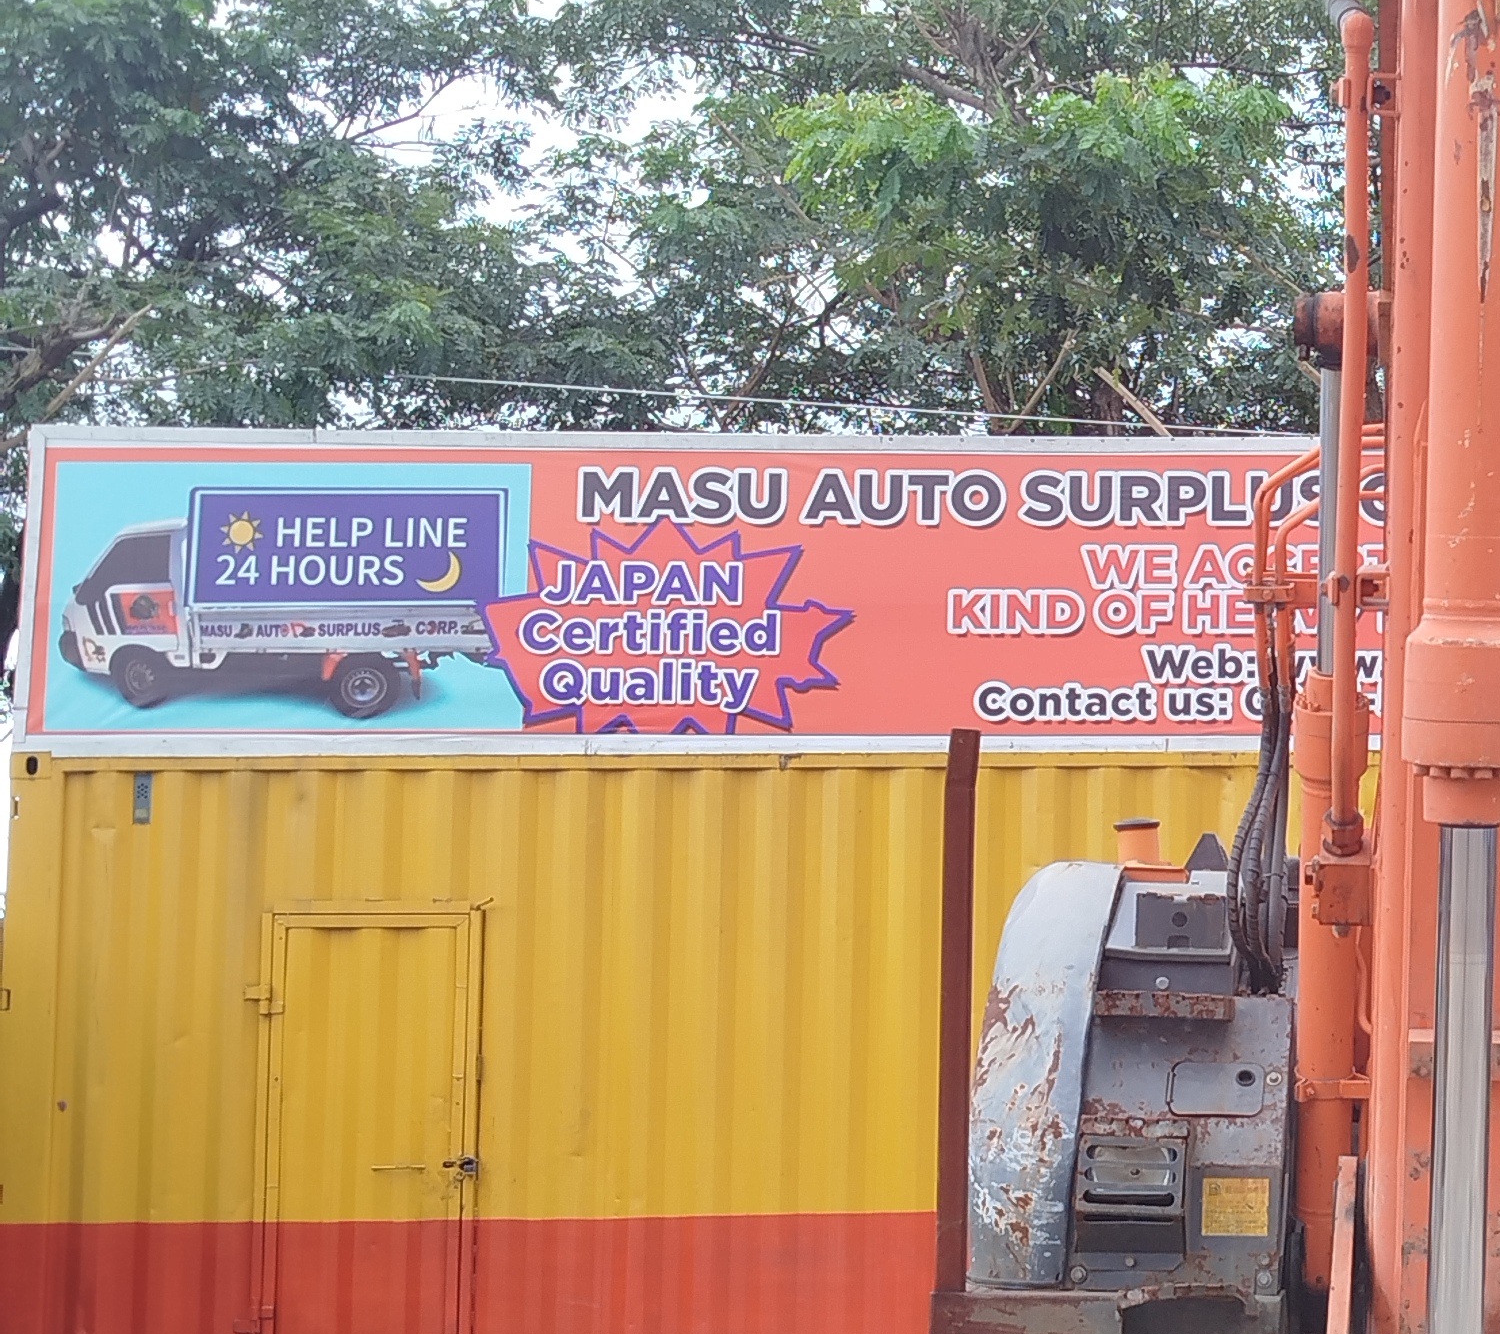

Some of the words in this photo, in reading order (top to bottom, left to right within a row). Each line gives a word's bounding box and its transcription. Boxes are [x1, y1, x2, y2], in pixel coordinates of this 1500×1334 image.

[577, 466, 788, 525] MASU
[800, 468, 1007, 527] AUTO
[277, 517, 374, 547] HELP
[384, 517, 468, 547] LINE
[215, 554, 259, 586] 24
[270, 554, 405, 586] HOURS
[540, 560, 743, 605] JAPAN
[1081, 543, 1178, 589] WE
[200, 624, 233, 638] MASU
[318, 622, 382, 638] SURPLUS
[415, 620, 459, 636] CORP.
[519, 609, 780, 655] Certified
[947, 587, 1086, 635] KIND
[1092, 588, 1174, 635] OF
[539, 658, 758, 713] Quality
[1142, 644, 1259, 683] Web:
[974, 680, 1157, 723] Contact
[1164, 684, 1234, 723] us:
